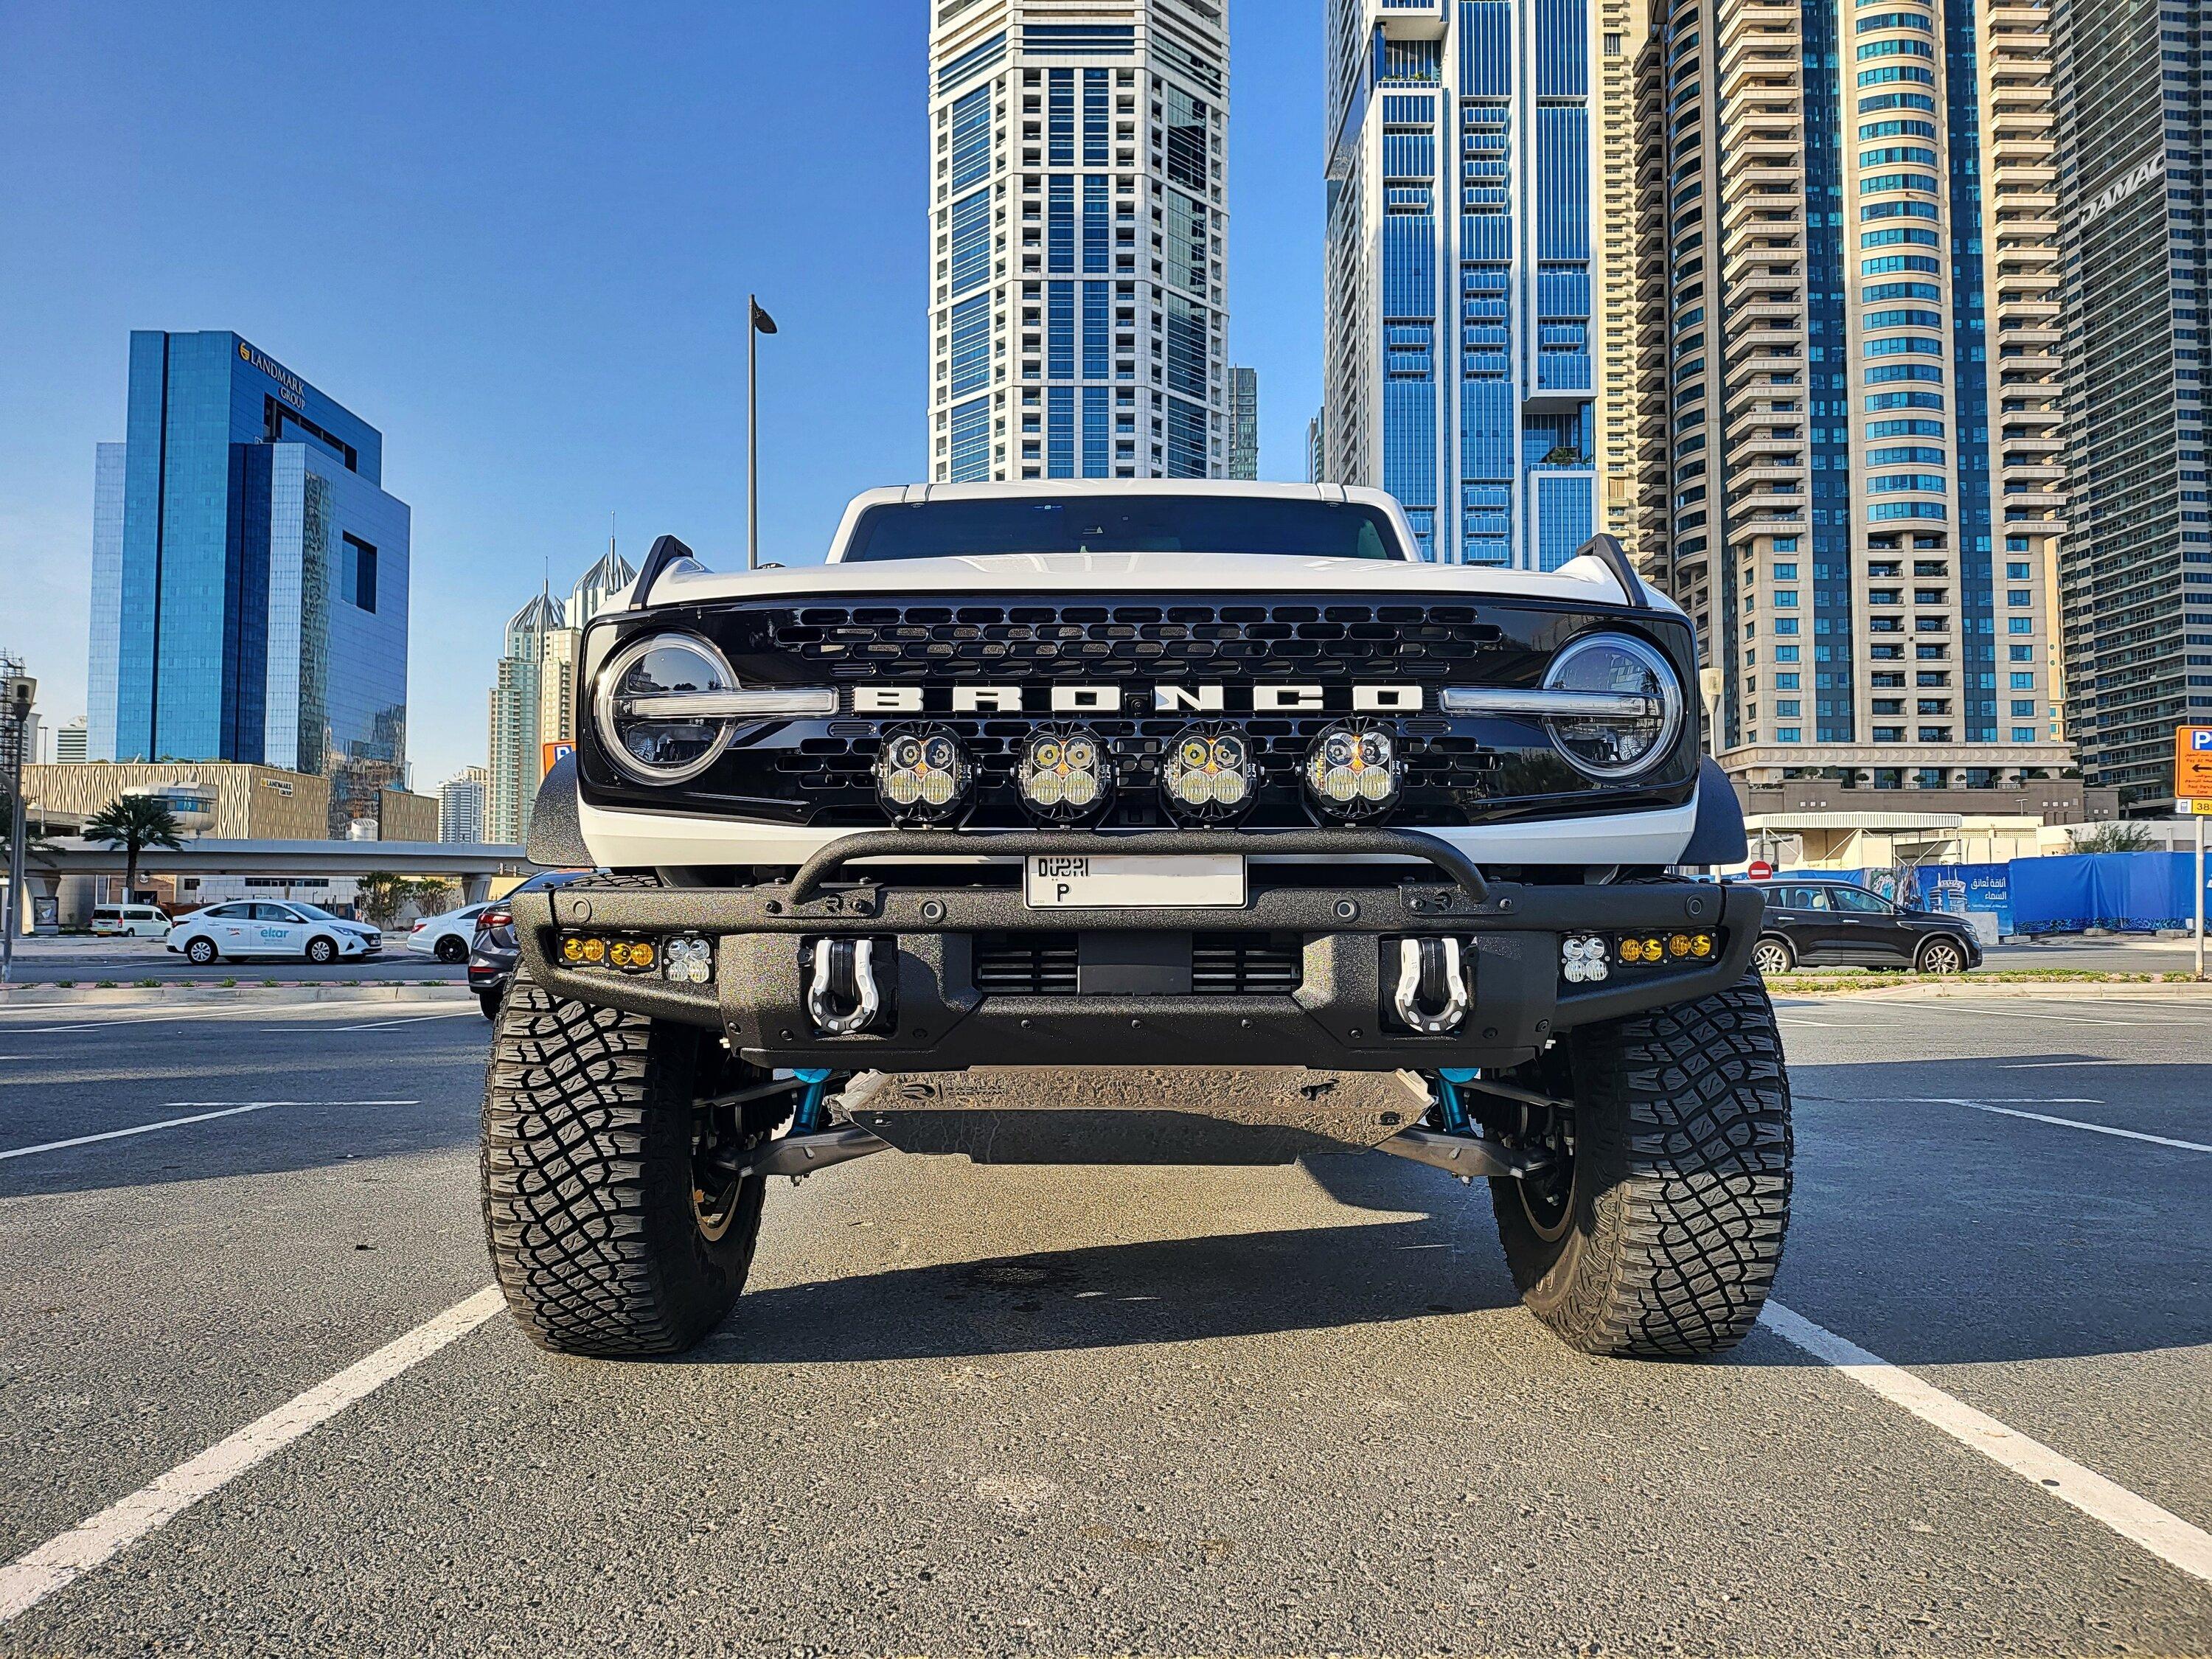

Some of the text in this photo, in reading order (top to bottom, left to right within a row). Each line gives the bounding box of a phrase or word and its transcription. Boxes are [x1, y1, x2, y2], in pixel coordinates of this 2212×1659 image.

[2080, 151, 2165, 227] DAMAC
[251, 349, 305, 398] LANDMARK
[280, 387, 306, 410] GROUP
[855, 686, 1423, 712] BRONCO
[2194, 731, 2211, 749] P
[556, 746, 570, 761] P
[266, 780, 292, 790] LANDMARK
[1990, 877, 2006, 888] أناقة
[1057, 883, 1070, 902] P
[1985, 891, 2006, 900] السماء
[260, 926, 289, 938] ekar
